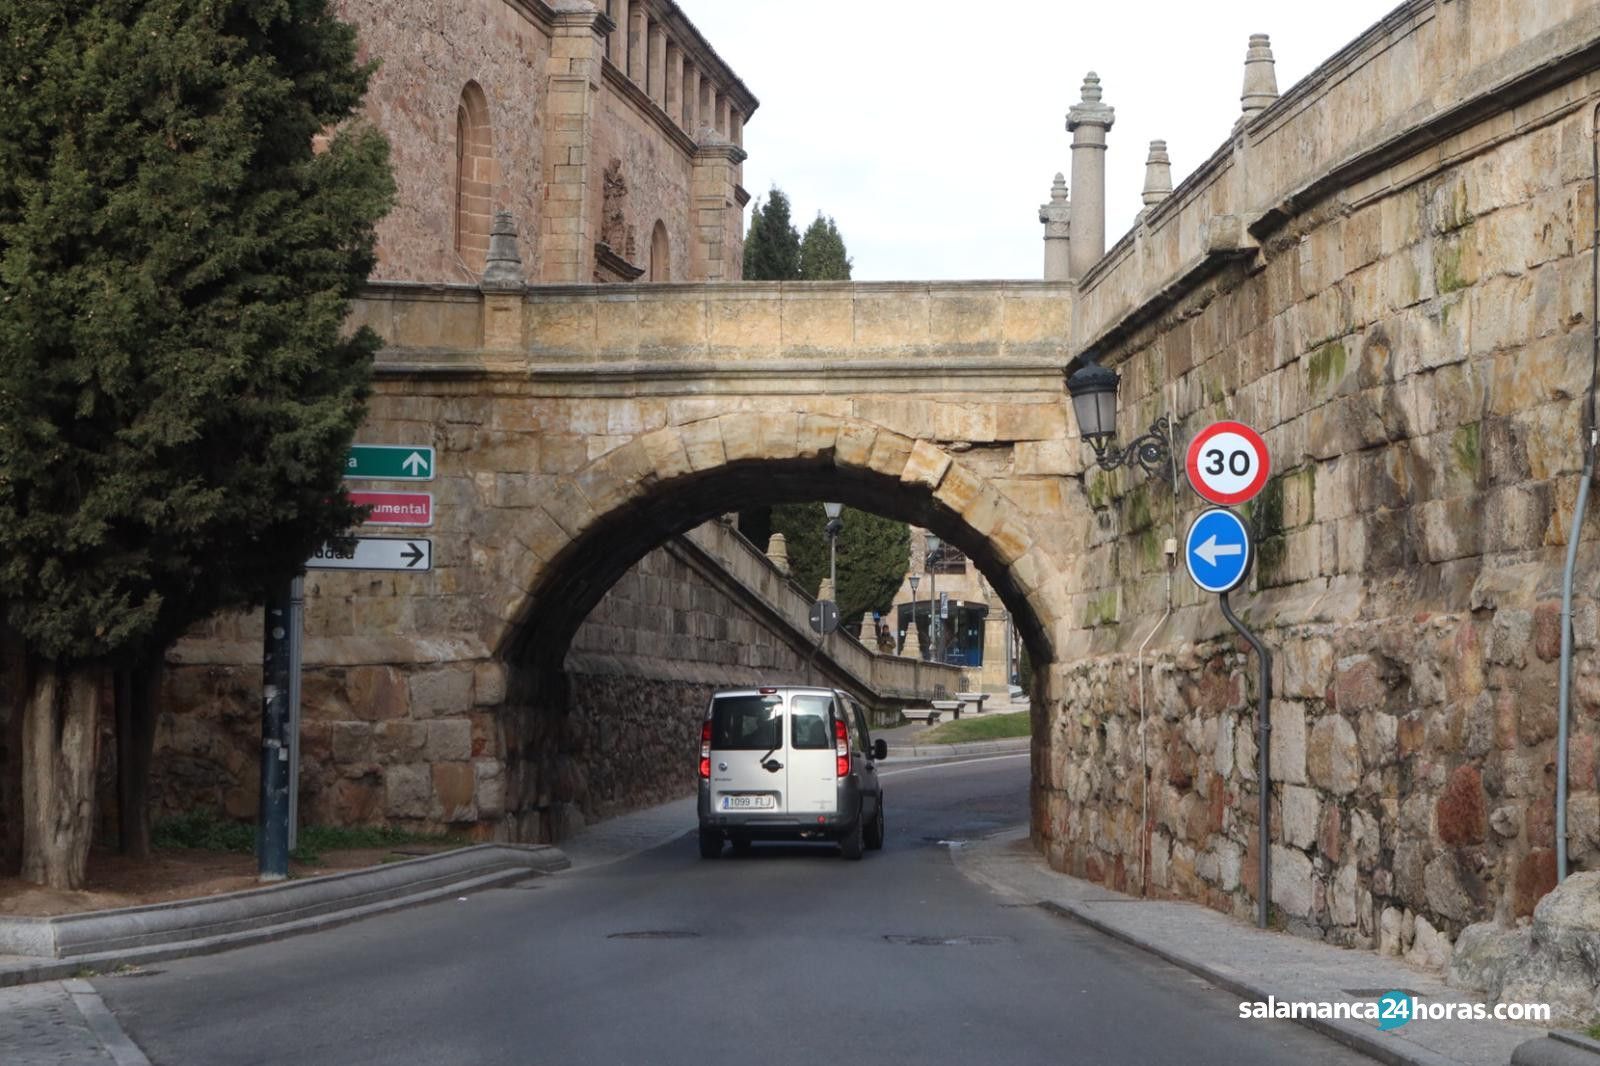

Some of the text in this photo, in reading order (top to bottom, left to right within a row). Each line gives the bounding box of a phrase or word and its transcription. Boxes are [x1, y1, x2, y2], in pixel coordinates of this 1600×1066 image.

[1205, 449, 1250, 476] 30
[373, 503, 427, 515] umental
[731, 797, 750, 806] 1099
